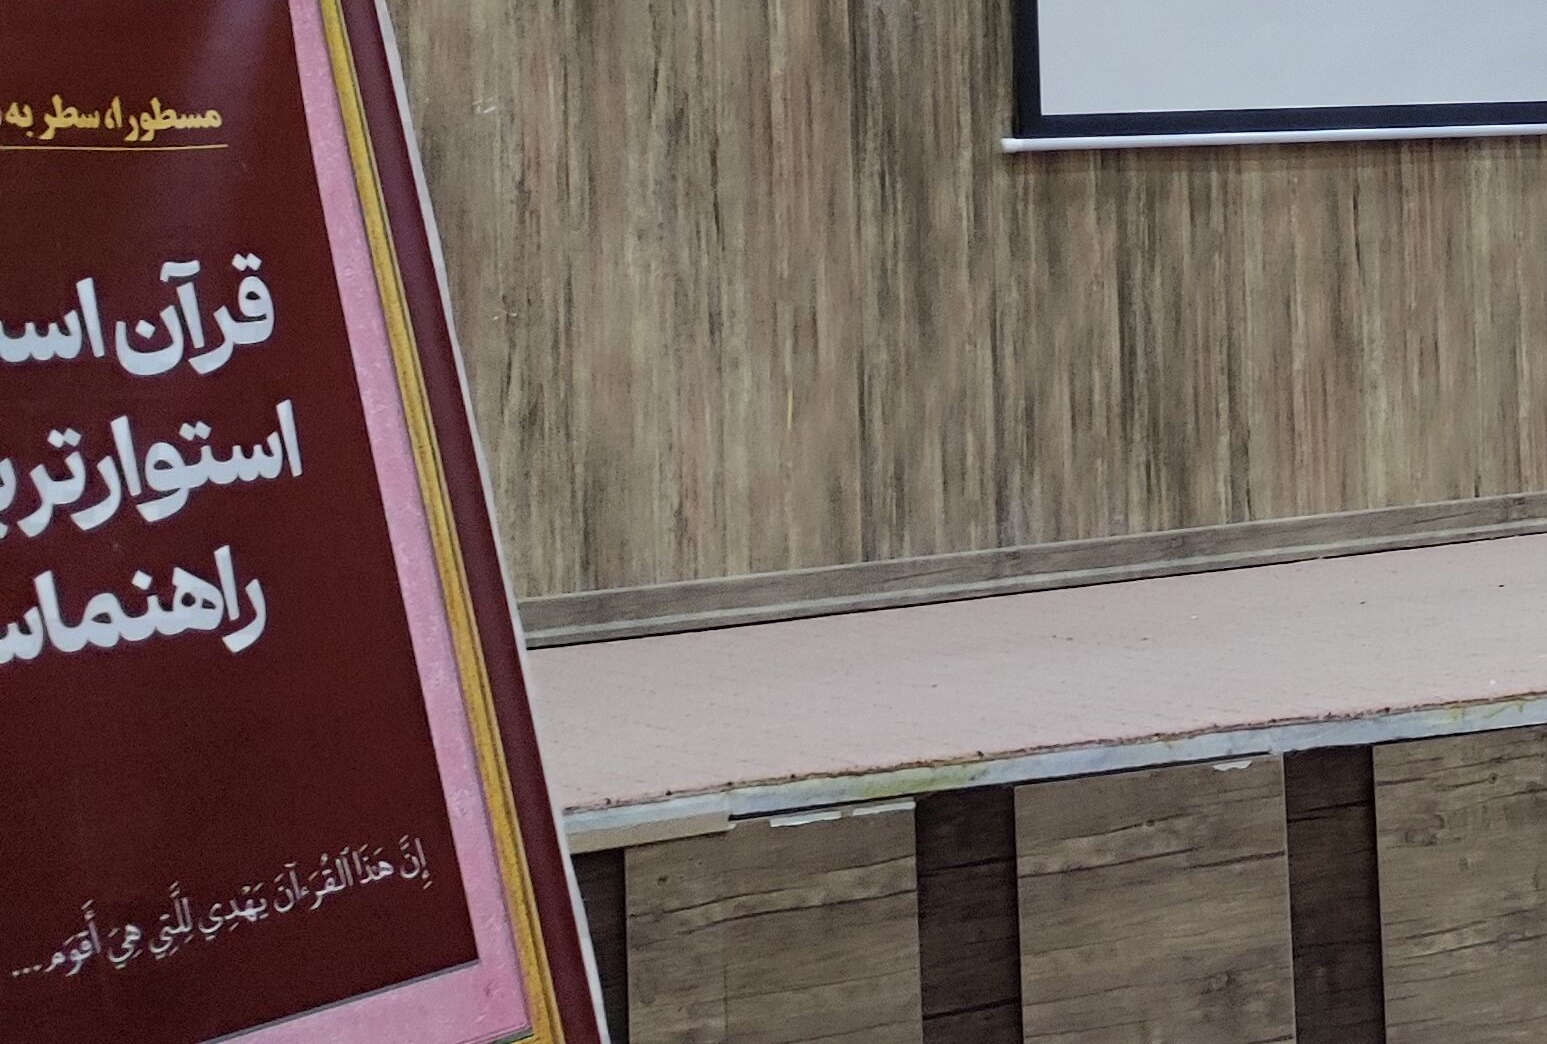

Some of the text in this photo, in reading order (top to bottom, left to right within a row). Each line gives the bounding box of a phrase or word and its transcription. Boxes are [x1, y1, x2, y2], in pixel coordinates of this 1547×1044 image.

[5, 101, 34, 138] به
[40, 93, 101, 141] سطر
[0, 252, 276, 376] قرآن اس
[0, 543, 267, 665] راهنماس
